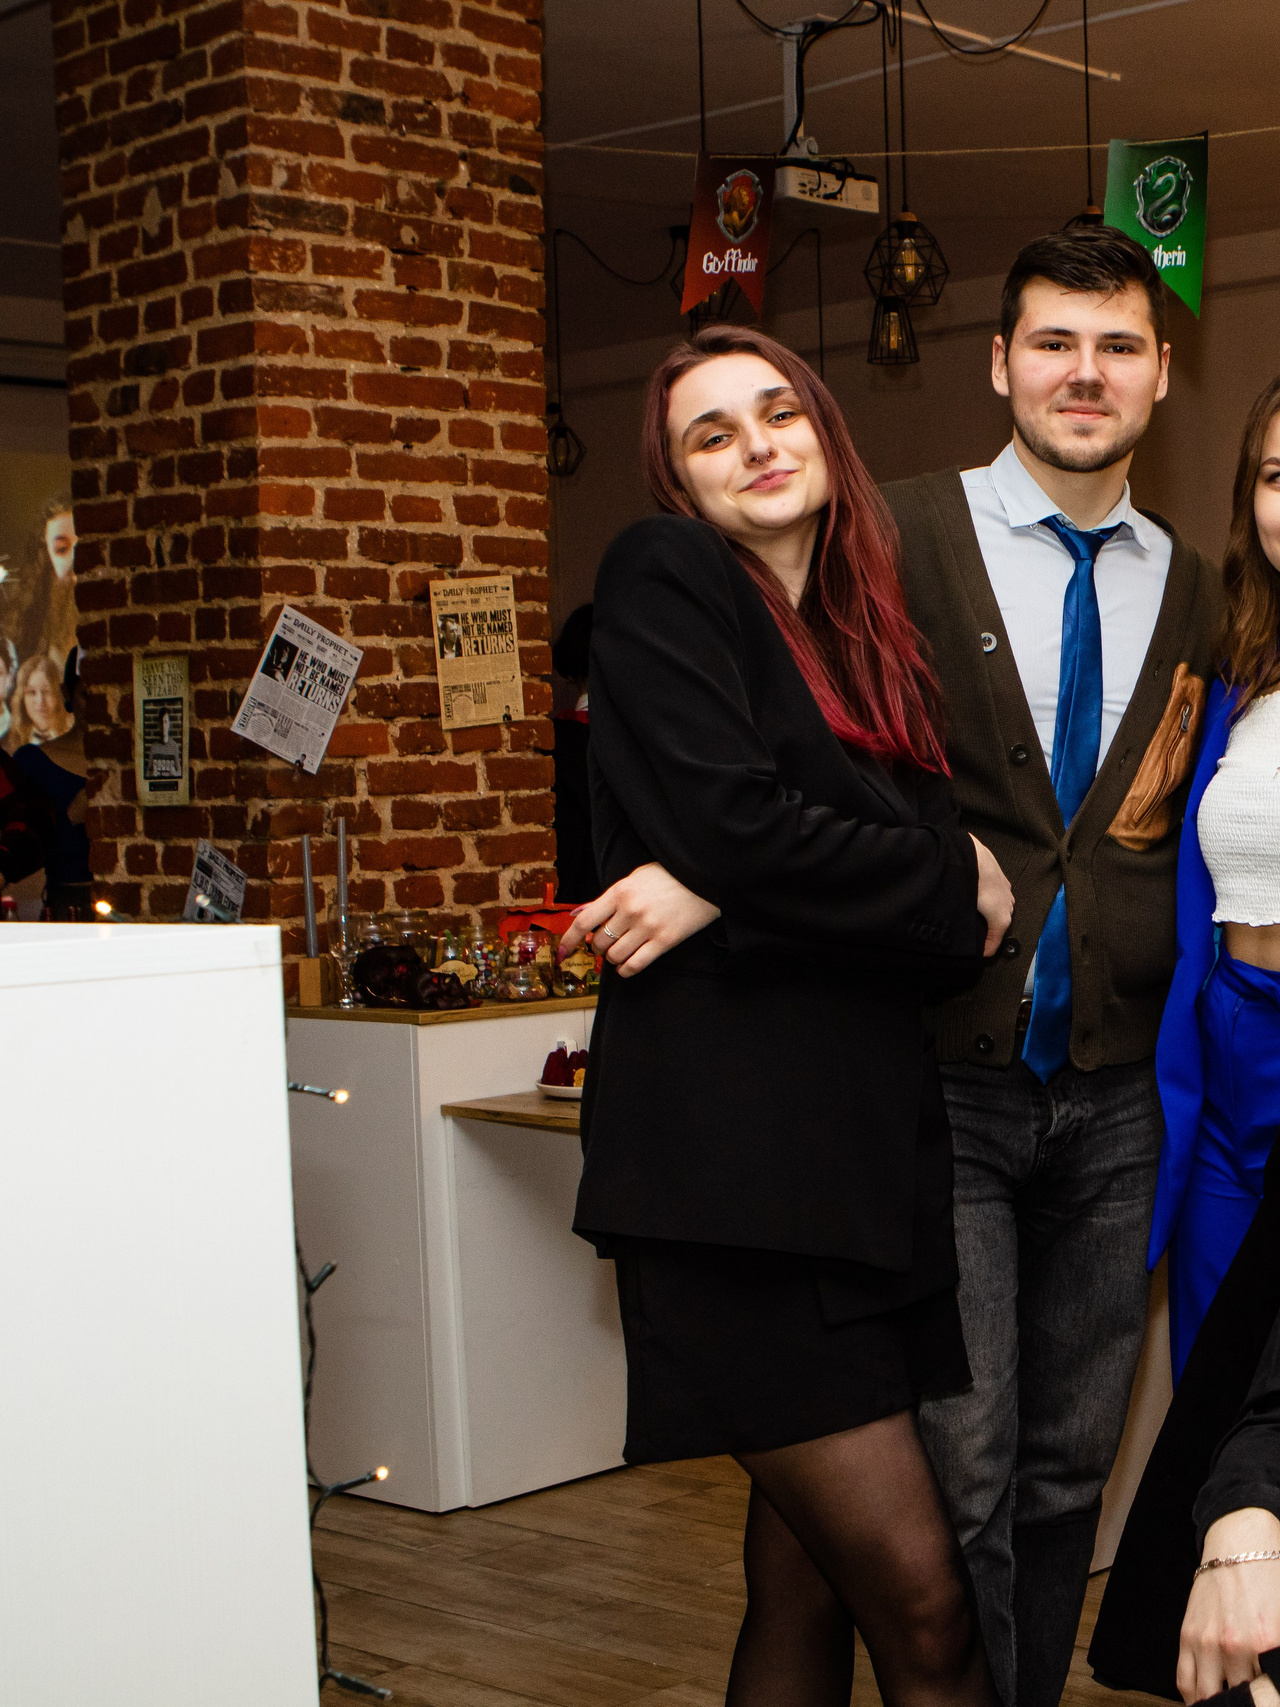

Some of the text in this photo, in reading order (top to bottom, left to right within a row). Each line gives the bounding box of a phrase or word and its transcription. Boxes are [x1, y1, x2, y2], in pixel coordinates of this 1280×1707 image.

[703, 248, 758, 274] Gryffindor
[1152, 243, 1187, 269] therin
[442, 585, 499, 597] DAILY PROPHET
[461, 609, 511, 625] HE WHO MUST
[462, 621, 513, 636] NOT BE NAMED
[293, 618, 316, 637] DAILY
[316, 631, 349, 657] PROPHET
[463, 633, 515, 657] RETURNS
[293, 661, 346, 697] NOT BE NAMED
[298, 650, 310, 664] HE
[310, 655, 327, 674] WHO
[328, 666, 350, 685] MUST
[287, 671, 341, 714] RETURNS
